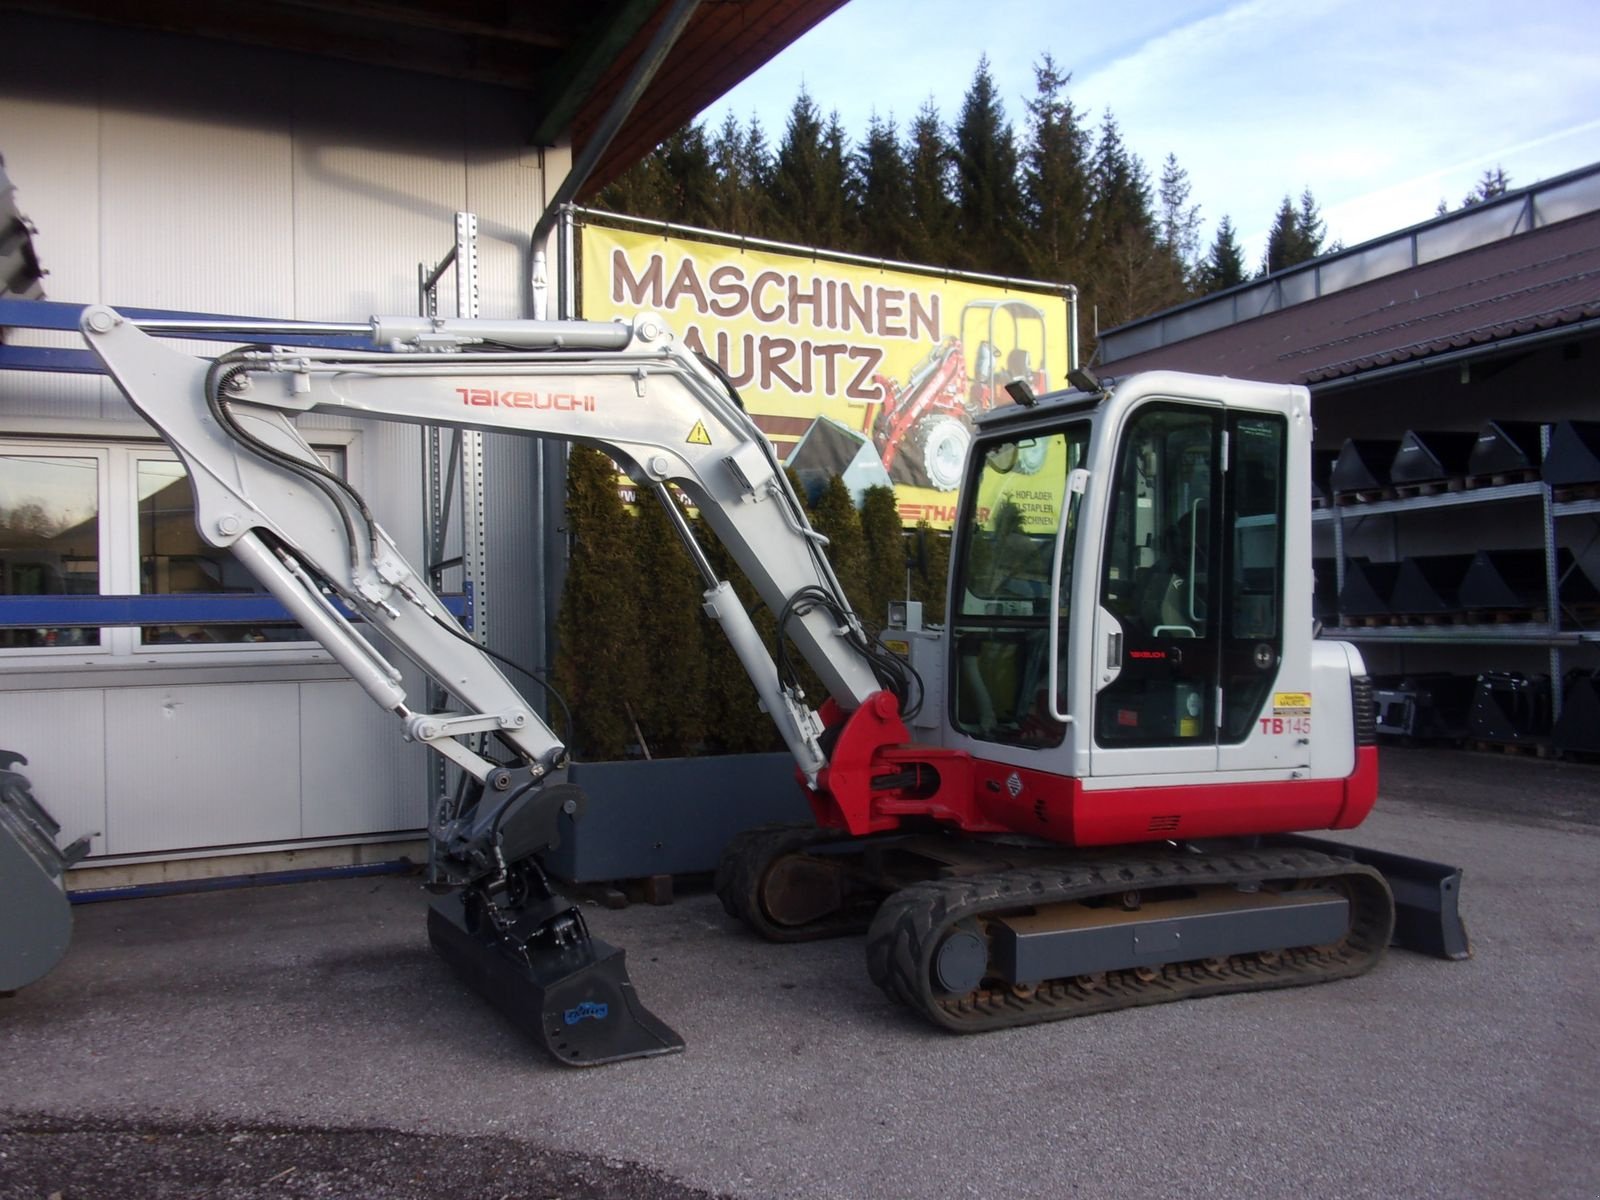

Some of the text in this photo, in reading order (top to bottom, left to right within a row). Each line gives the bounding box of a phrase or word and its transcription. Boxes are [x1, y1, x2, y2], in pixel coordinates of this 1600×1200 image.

[612, 249, 941, 342] MASCHINEN
[684, 326, 883, 399] AURITZ
[455, 388, 596, 412] TAKEUCHI
[1015, 490, 1053, 500] HOFLADER
[922, 504, 990, 523] THAR
[1023, 515, 1053, 526] SCHINEN
